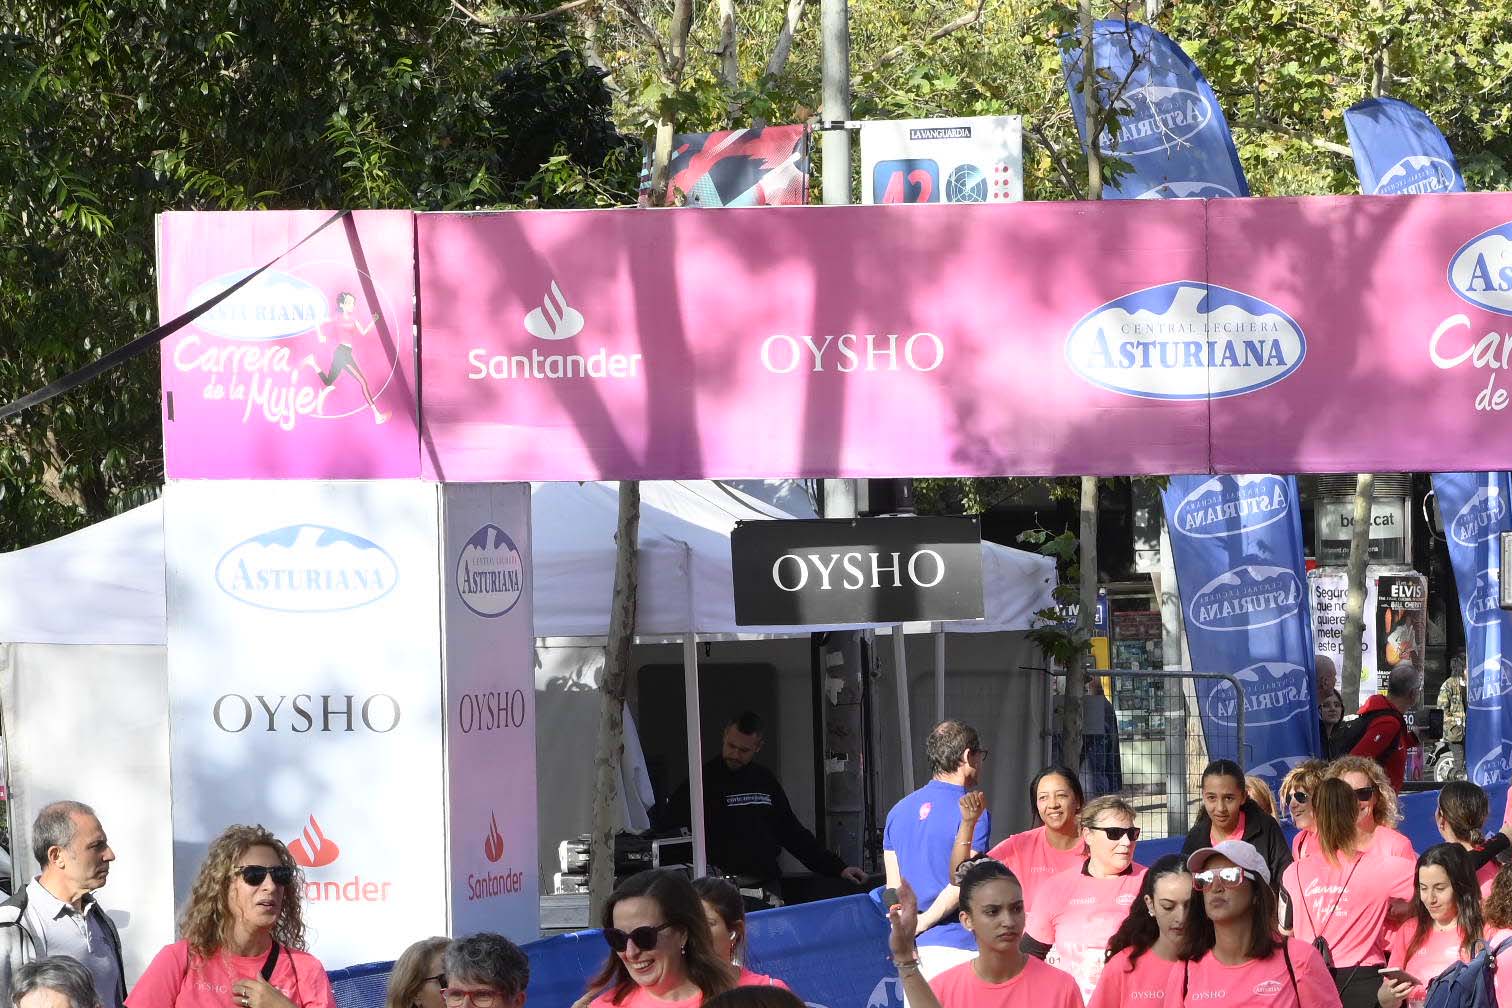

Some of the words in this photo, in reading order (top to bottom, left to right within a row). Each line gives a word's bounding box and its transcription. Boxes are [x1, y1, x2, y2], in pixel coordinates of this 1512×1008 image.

[1120, 322, 1199, 335] CENTRAL
[1203, 320, 1279, 334] LECHERA
[174, 335, 291, 372] Carrera
[468, 347, 642, 380] Santander
[760, 332, 945, 374] OYSHO
[1088, 327, 1287, 369] ASTURIANA
[203, 374, 224, 399] de
[229, 371, 244, 399] la
[243, 370, 335, 430] Mujer
[1475, 372, 1509, 412] de
[233, 557, 385, 591] ASTURIANA
[462, 560, 519, 594] ASTURIANA
[772, 549, 945, 592] OYSHO
[1317, 602, 1333, 613] que
[1391, 585, 1421, 598] ELVIS
[1319, 641, 1337, 652] este
[213, 694, 400, 733] OYSHO
[459, 689, 526, 733] OYSHO
[467, 870, 524, 901] Santander
[1131, 991, 1165, 1000] OYSHO
[1192, 990, 1226, 1000] OYSHO
